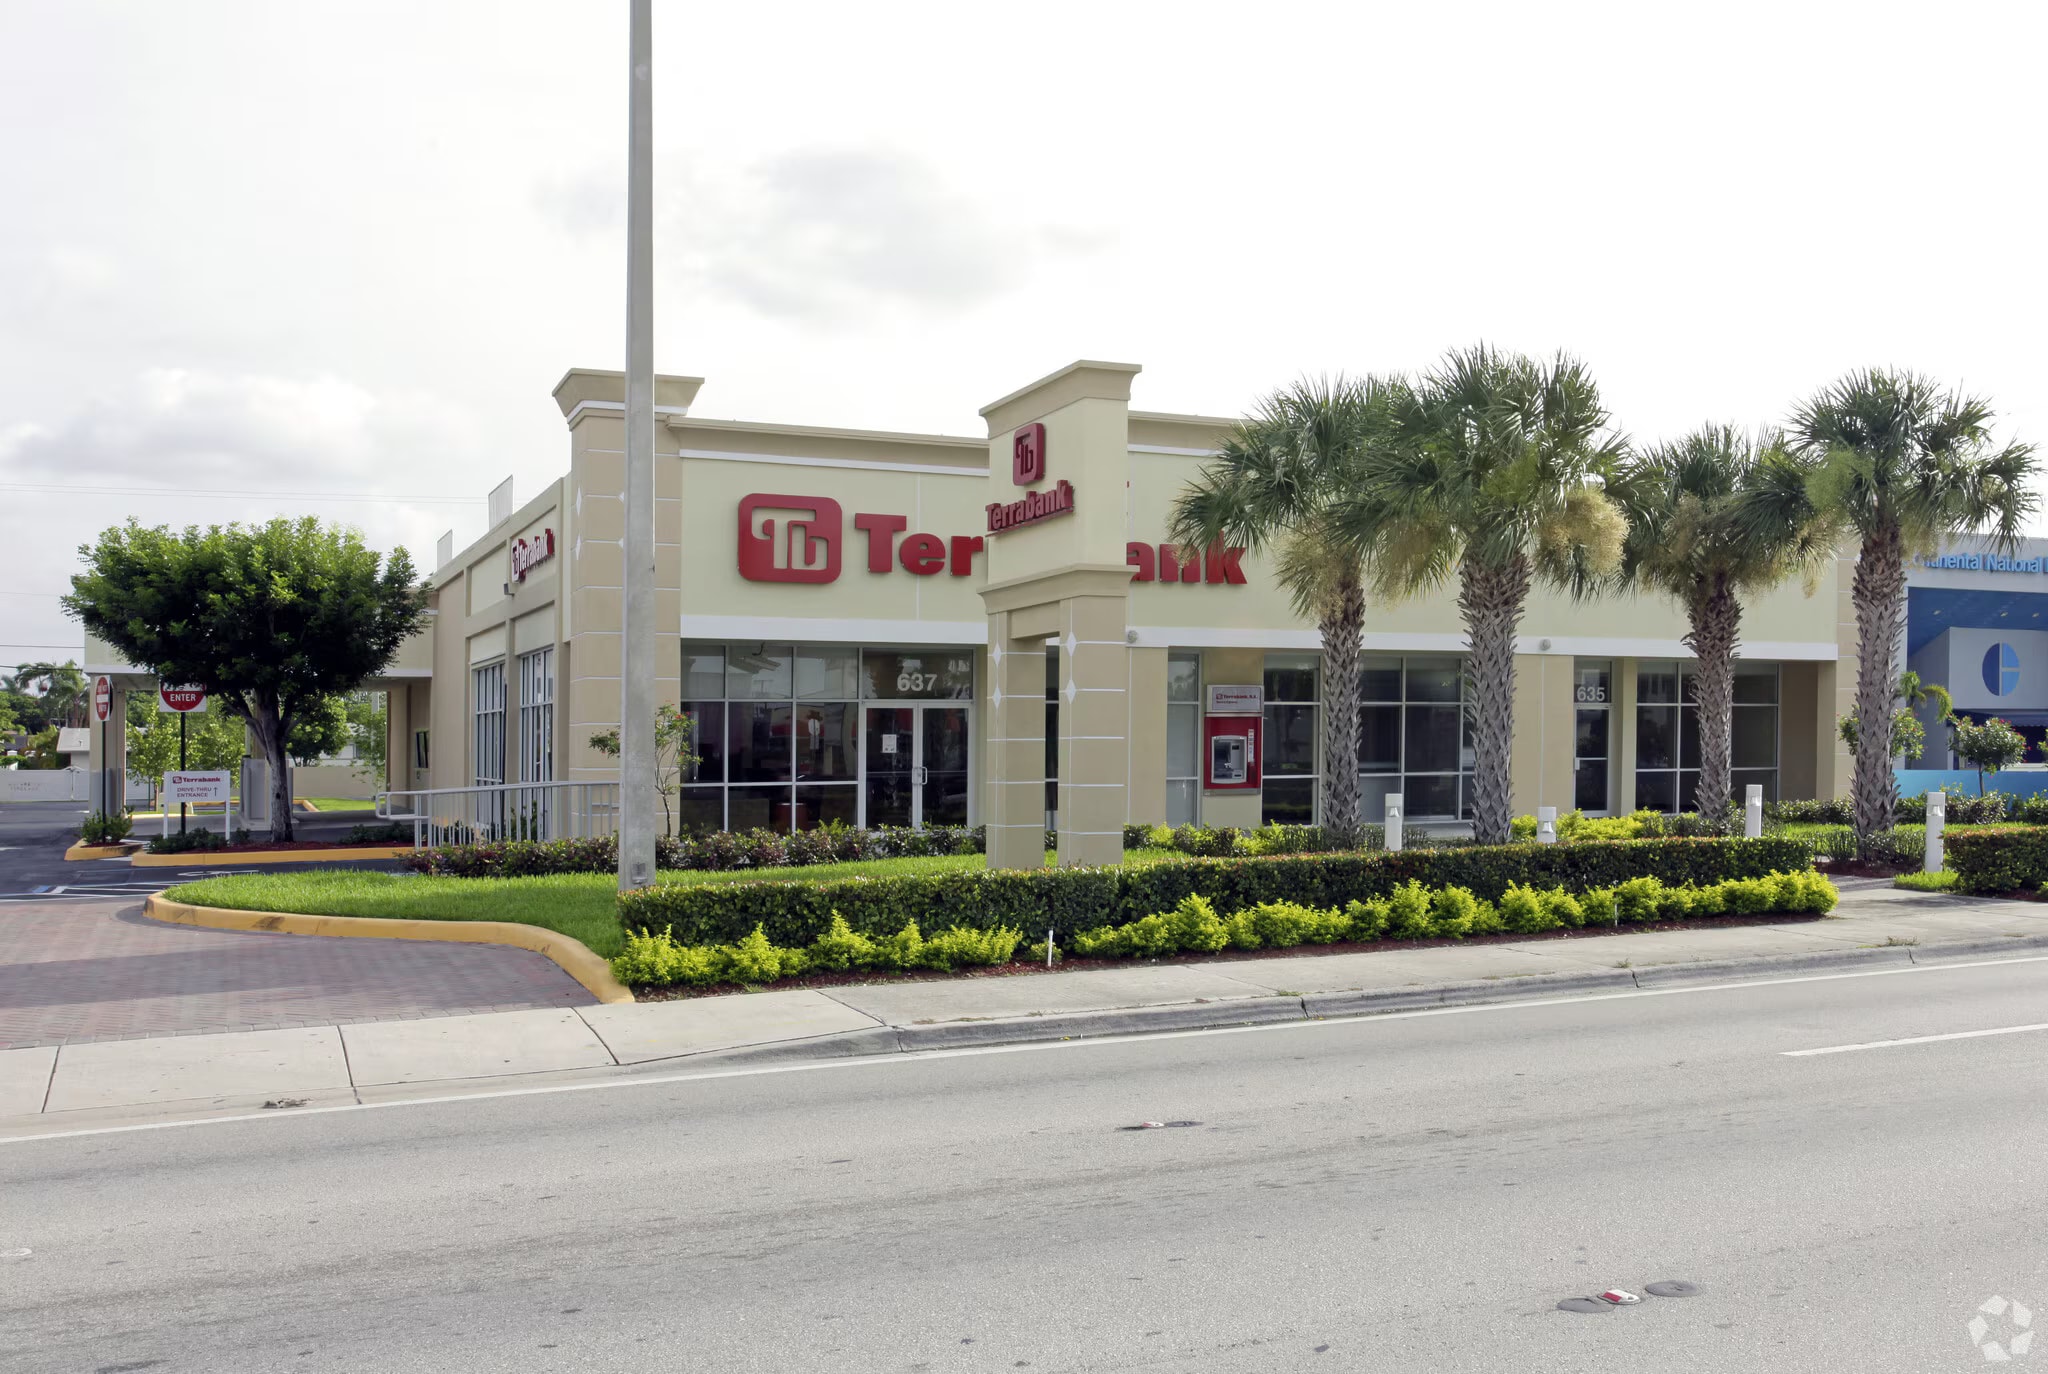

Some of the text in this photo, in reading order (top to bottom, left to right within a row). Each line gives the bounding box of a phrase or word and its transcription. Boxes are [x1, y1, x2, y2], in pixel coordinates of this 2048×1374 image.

[985, 480, 1073, 532] Terrabank
[855, 512, 1248, 585] Terank
[1984, 553, 2042, 574] National
[897, 673, 938, 692] 637
[170, 693, 196, 702] ENTER
[1577, 686, 1605, 702] 635
